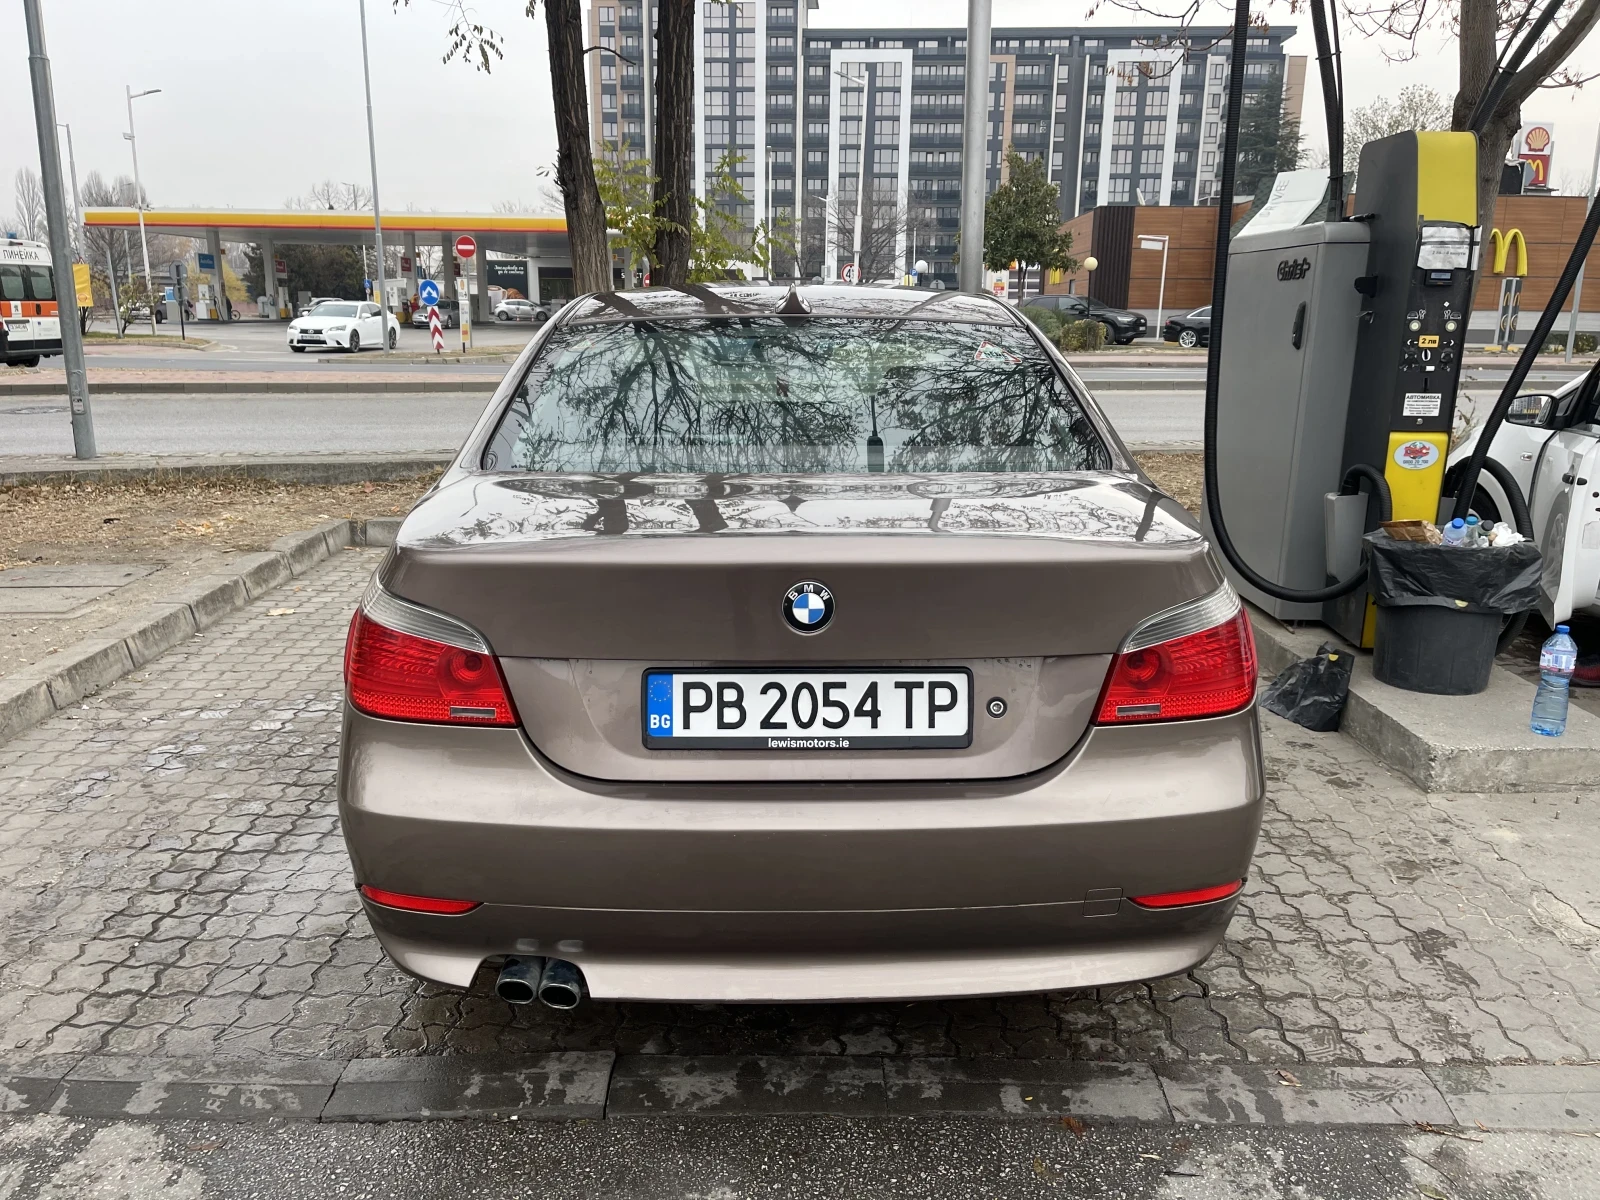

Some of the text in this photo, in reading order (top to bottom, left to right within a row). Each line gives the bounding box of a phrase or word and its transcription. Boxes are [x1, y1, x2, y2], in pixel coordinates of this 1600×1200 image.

[788, 584, 830, 601] BMW
[682, 681, 958, 730] PB 2054 TP
[650, 714, 671, 729] BG
[768, 737, 850, 748] lewismotors.ie
